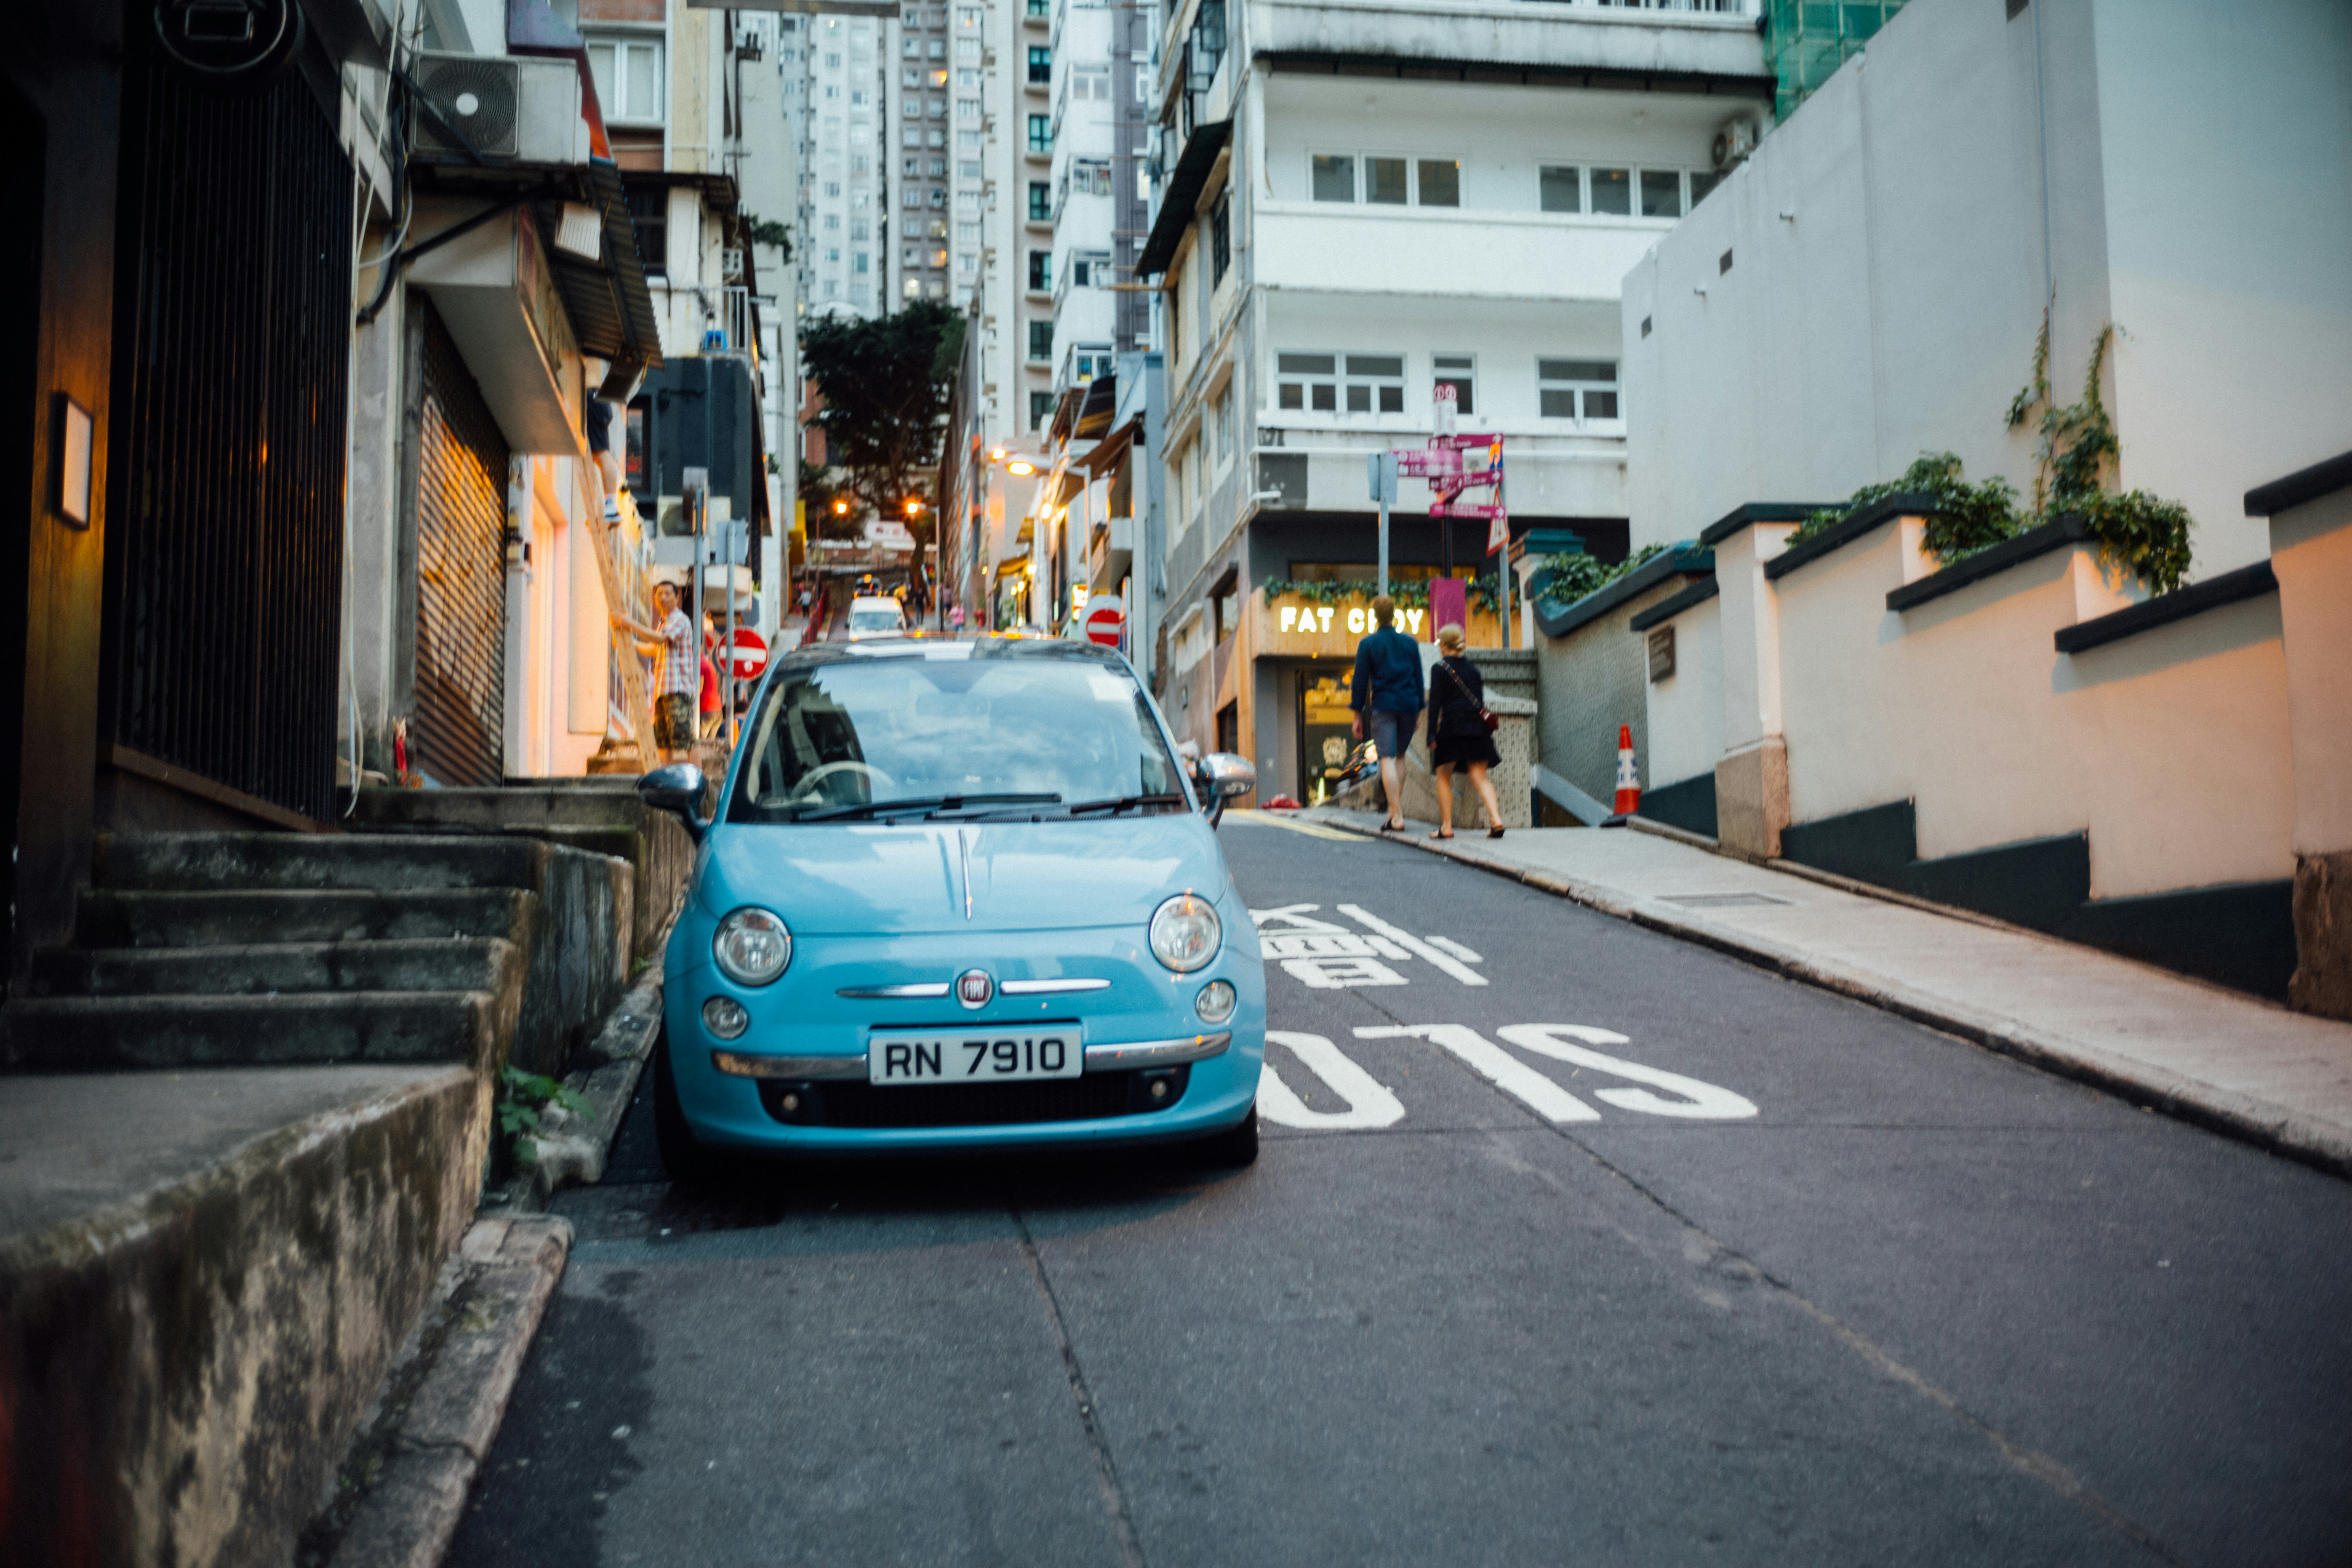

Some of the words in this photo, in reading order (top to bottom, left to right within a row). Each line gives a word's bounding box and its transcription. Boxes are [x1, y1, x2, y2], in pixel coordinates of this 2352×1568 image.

[1281, 607, 1334, 633] FAT
[1249, 904, 1488, 987] 慢
[886, 1042, 941, 1077] RN
[963, 1039, 1065, 1075] 7910
[1256, 1023, 1758, 1128] SLO
